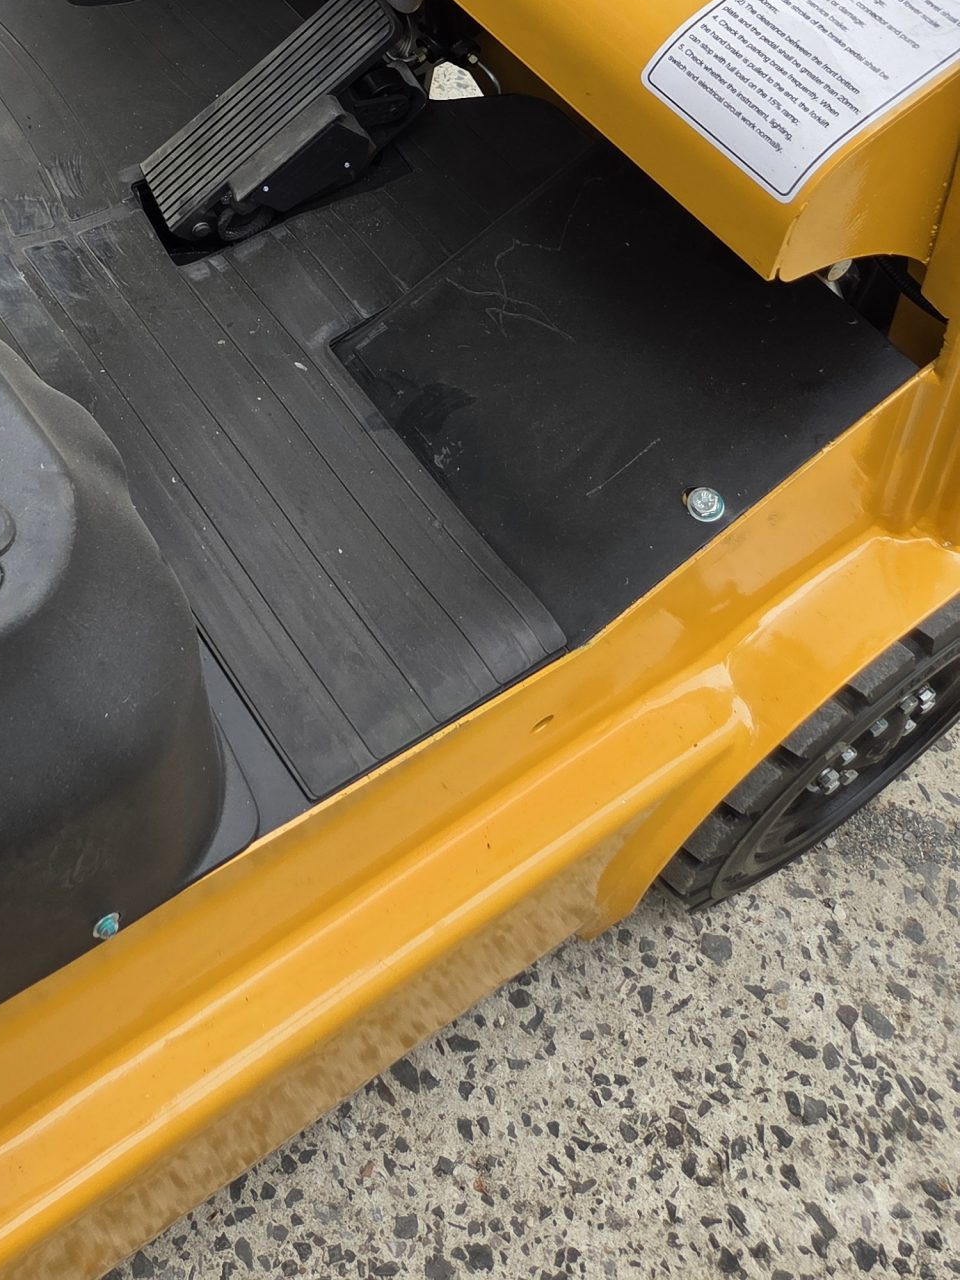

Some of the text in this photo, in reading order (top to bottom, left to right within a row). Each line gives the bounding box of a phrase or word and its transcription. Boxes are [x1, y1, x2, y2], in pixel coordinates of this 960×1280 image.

[685, 49, 704, 67] Check
[703, 65, 728, 85] whether
[726, 83, 737, 94] the
[689, 34, 701, 44] can
[700, 43, 714, 55] stop
[713, 53, 726, 65] with
[725, 63, 737, 72] full
[734, 70, 750, 83] load
[748, 82, 757, 90] on
[756, 88, 767, 98] the
[768, 97, 782, 110] 15%
[700, 24, 711, 33] the
[710, 31, 727, 45] hand
[725, 43, 743, 59] brake
[747, 63, 769, 78] pulled
[766, 76, 774, 84] to
[773, 82, 784, 92] the
[798, 102, 809, 112] the
[809, 110, 829, 128] forklift
[719, 20, 738, 36] Check
[737, 35, 748, 44] the
[746, 43, 771, 63] parking
[769, 60, 788, 76] brake
[820, 99, 839, 117] When
[722, 6, 739, 19] plate
[738, 18, 752, 28] and
[750, 27, 761, 36] the
[759, 35, 779, 50] pedal
[777, 49, 795, 61] shall
[791, 59, 801, 68] be
[799, 67, 824, 85] greater
[823, 84, 838, 97] than
[745, 3, 757, 15] The
[756, 14, 786, 37] clearance
[785, 36, 812, 57] between
[811, 56, 822, 65] the
[822, 64, 838, 78] front
[836, 75, 860, 94] bottom
[791, 5, 811, 20] stroke
[817, 24, 828, 33] the
[827, 32, 846, 47] brake
[844, 47, 866, 61] pedal
[863, 60, 881, 73] shall
[879, 71, 889, 80] be
[668, 56, 687, 72] switch
[686, 71, 699, 82] and
[698, 80, 725, 103] electrical
[723, 101, 742, 118] circuit
[741, 116, 756, 130] work
